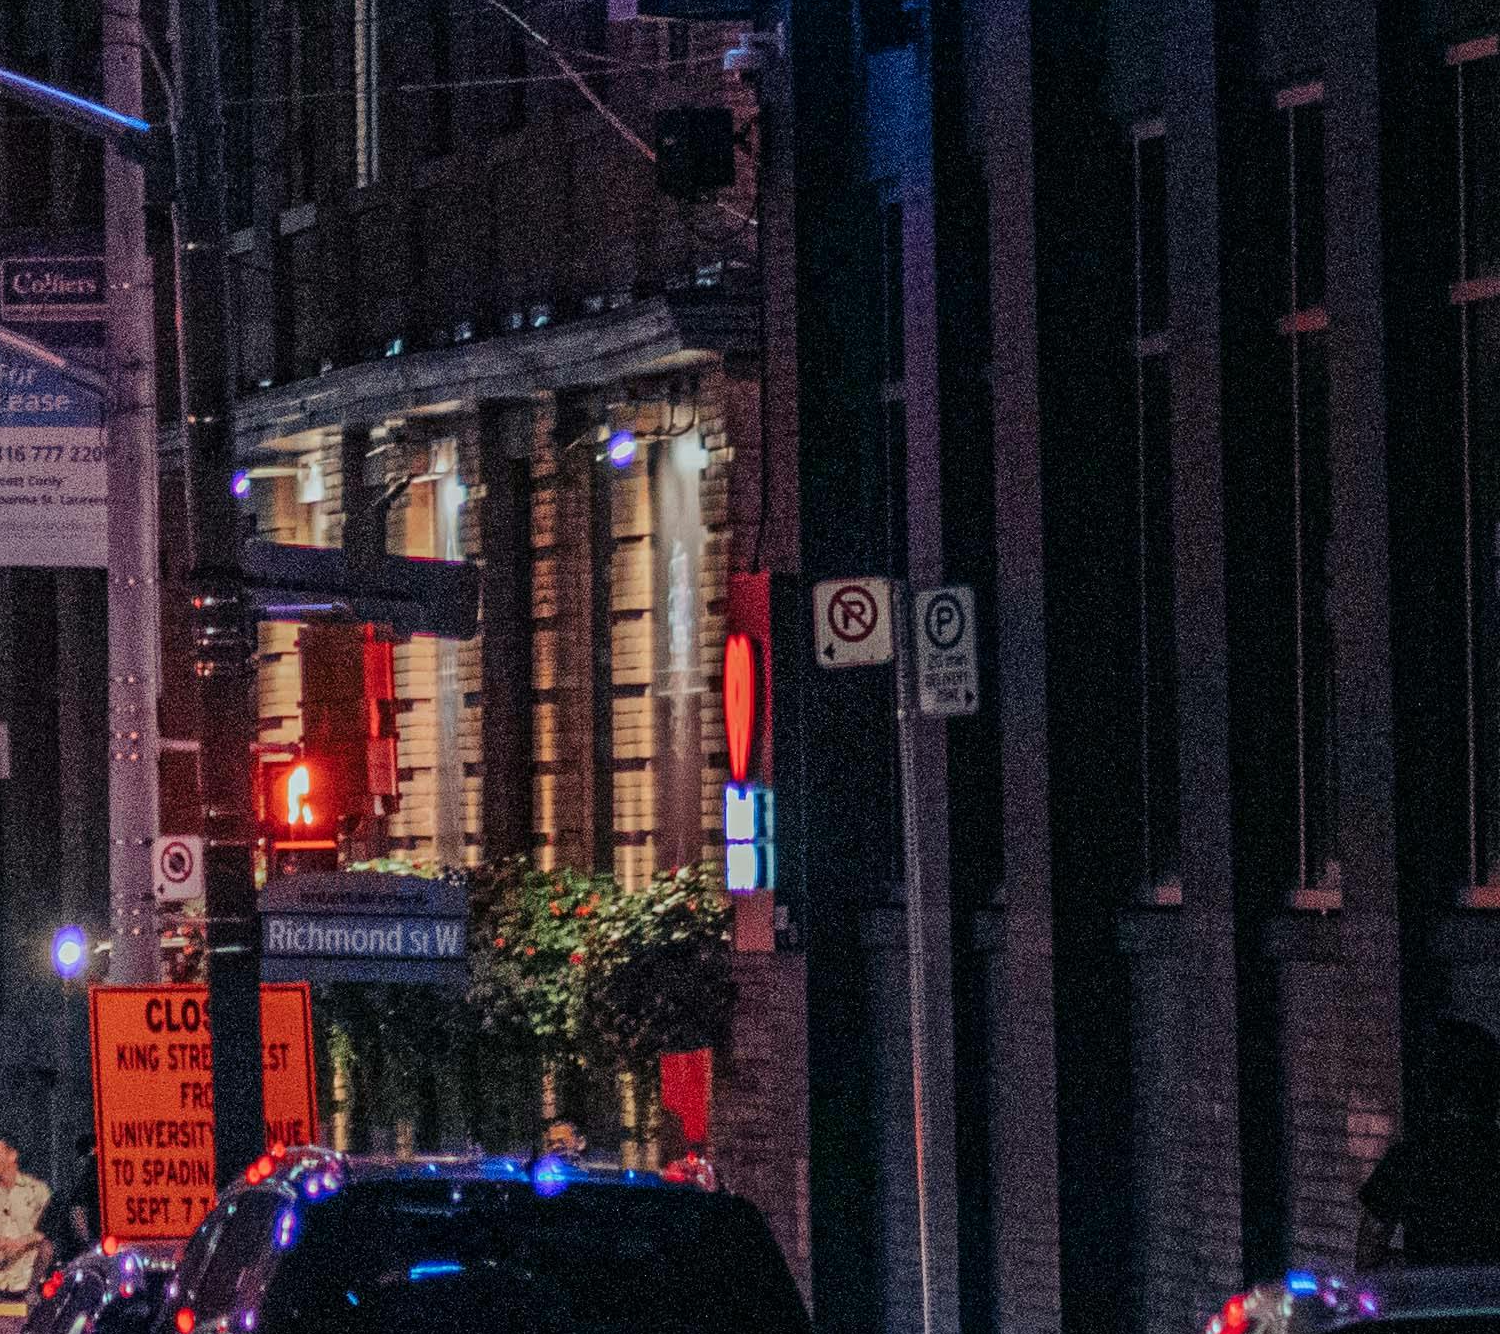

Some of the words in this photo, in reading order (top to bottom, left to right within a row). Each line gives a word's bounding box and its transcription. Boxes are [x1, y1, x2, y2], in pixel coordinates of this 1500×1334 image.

[11, 271, 97, 295] Colliers
[31, 445, 64, 463] 777
[267, 919, 403, 954] Richmond
[409, 929, 430, 954] St
[434, 923, 460, 955] W
[116, 1043, 159, 1071] KING
[167, 1043, 213, 1071] STRE
[111, 1158, 135, 1186] TO
[142, 1158, 213, 1186] SPADIN
[181, 1197, 194, 1224] 7
